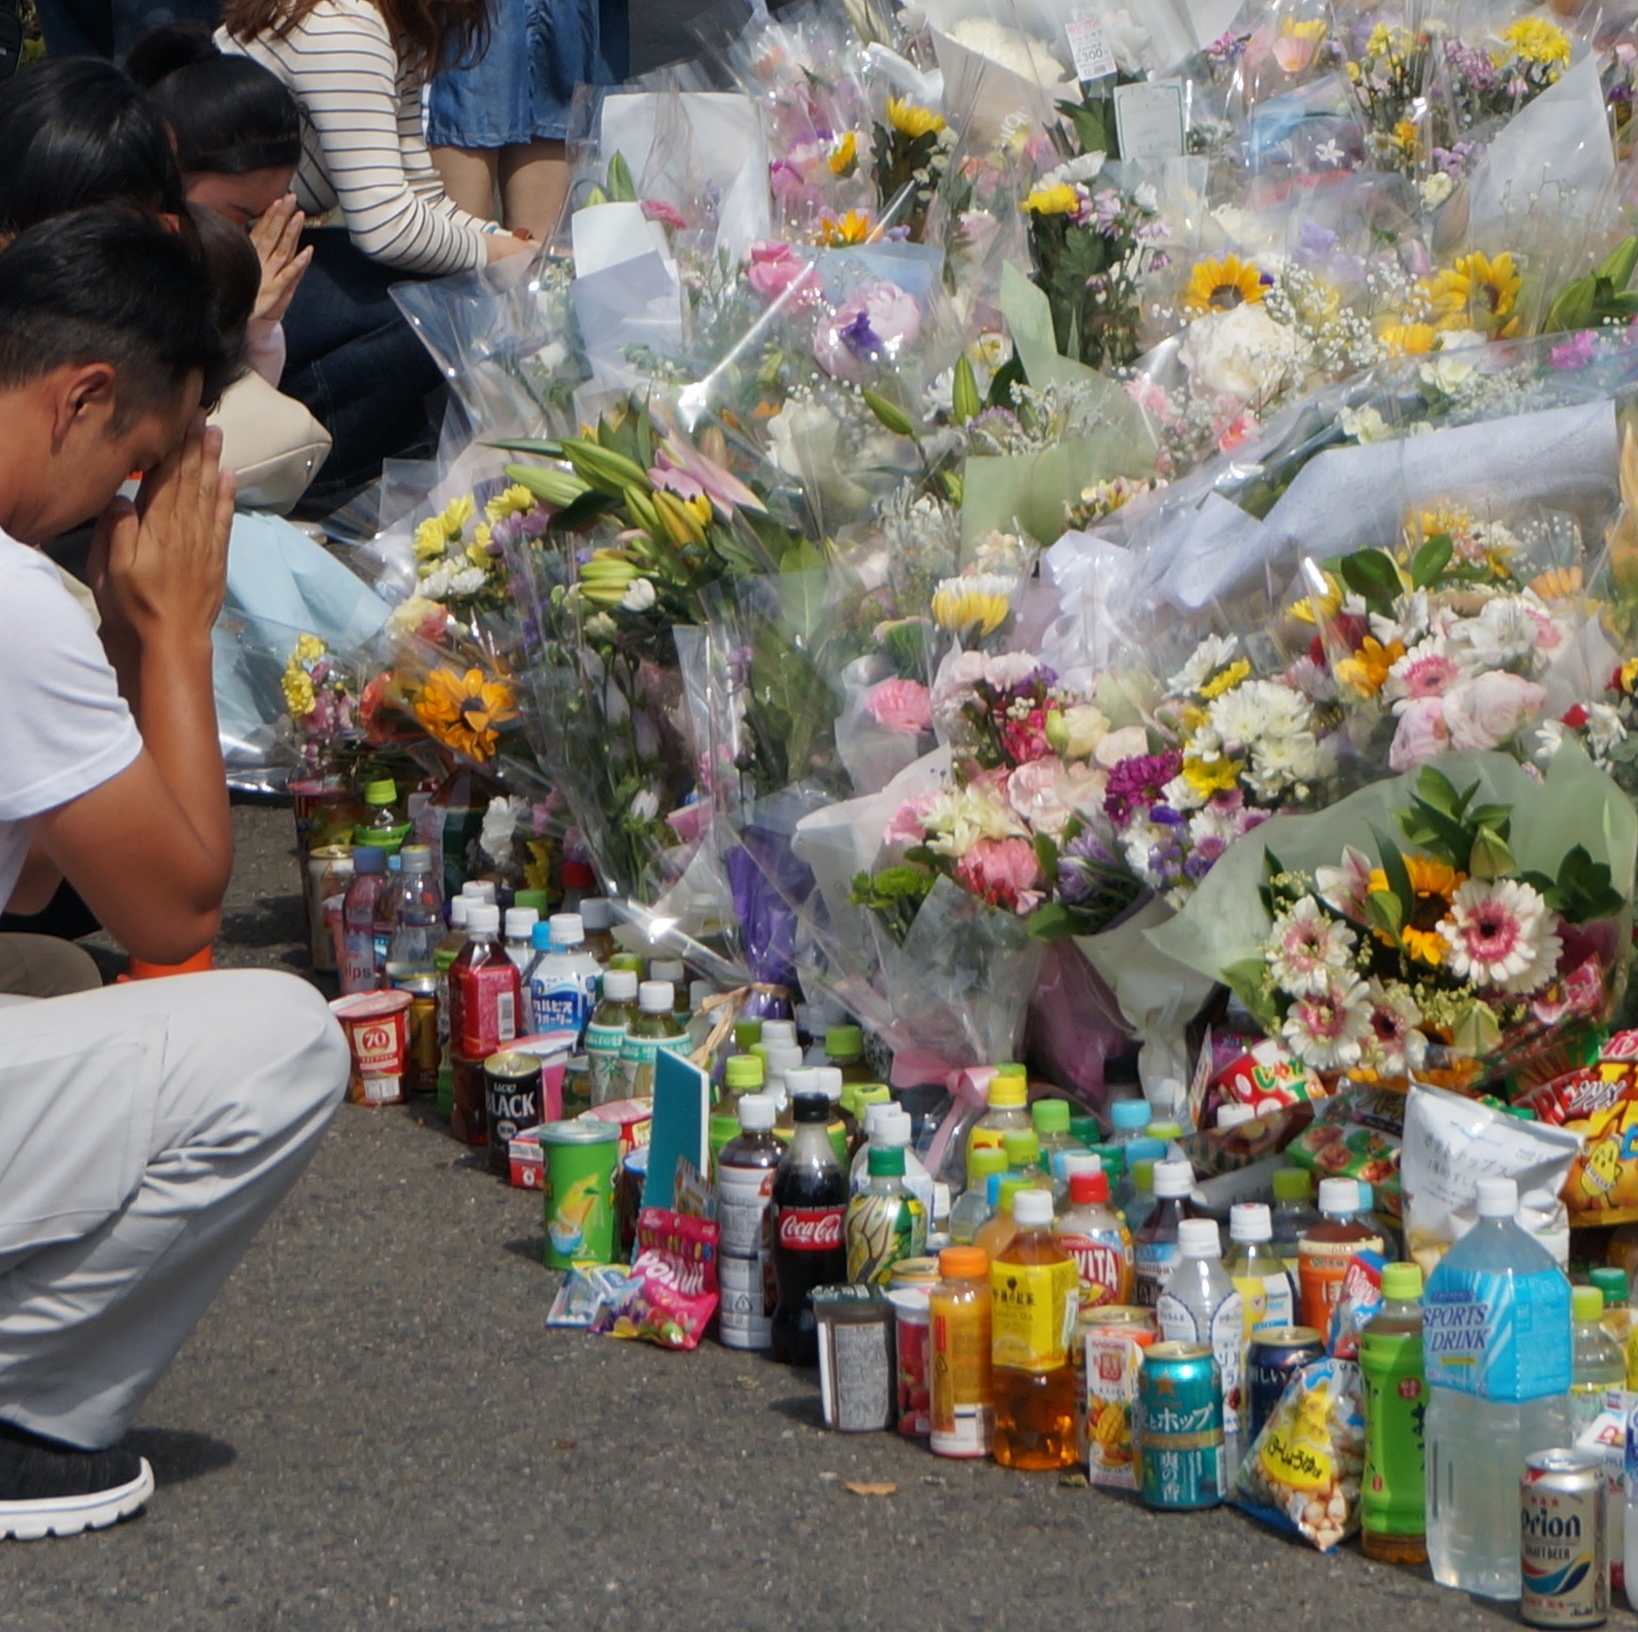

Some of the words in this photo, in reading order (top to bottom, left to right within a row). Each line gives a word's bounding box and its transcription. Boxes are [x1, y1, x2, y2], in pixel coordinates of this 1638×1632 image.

[1068, 1249, 1118, 1293] VITA
[1422, 1303, 1489, 1327] SPORTS
[1429, 1328, 1490, 1354] DRINK
[1142, 1401, 1215, 1433] とホップ
